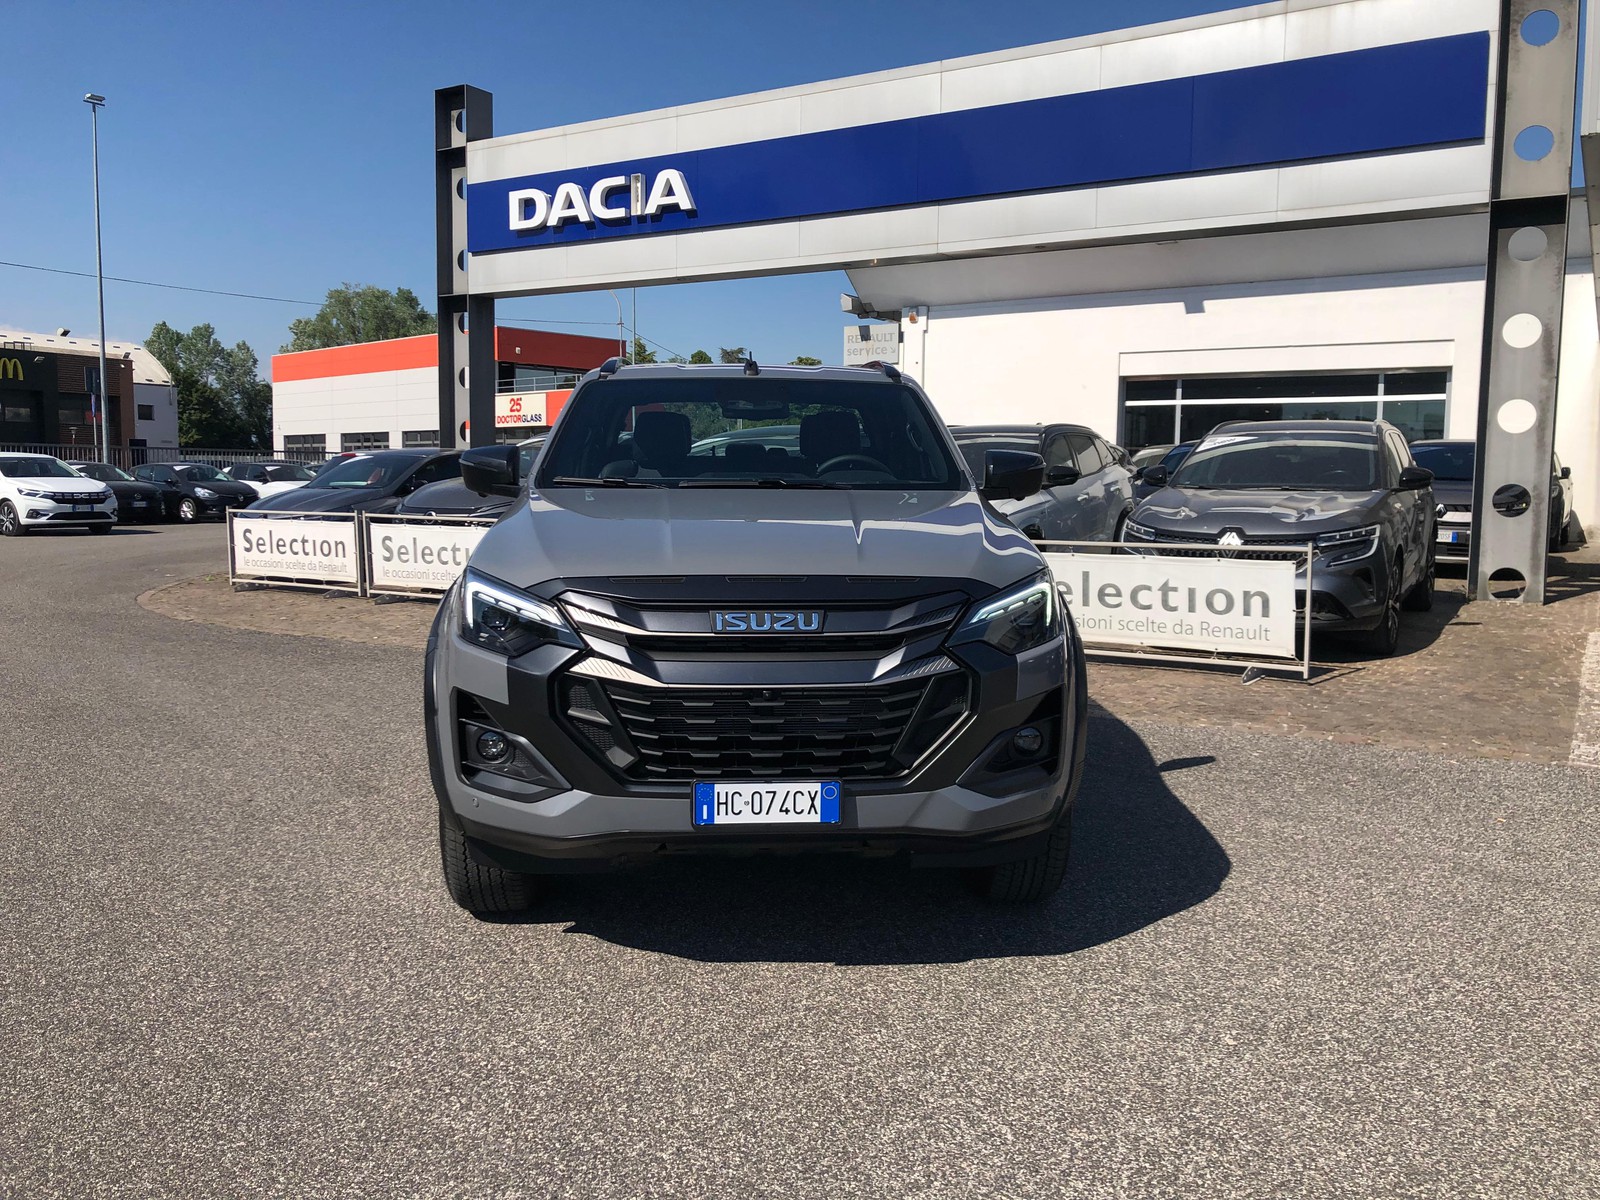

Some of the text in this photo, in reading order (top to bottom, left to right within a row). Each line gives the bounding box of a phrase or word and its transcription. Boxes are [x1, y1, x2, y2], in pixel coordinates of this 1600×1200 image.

[508, 168, 696, 231] DACIA
[847, 332, 895, 344] RENAULT
[847, 344, 888, 356] service
[496, 413, 542, 424] DOCTORGLASS
[242, 527, 346, 558] Selection
[381, 535, 470, 566] Selecti
[243, 556, 348, 573] le occasioni scelte da Renault
[383, 566, 457, 581] le occasioni scelte
[1055, 570, 1270, 618] election
[715, 612, 819, 631] ISUZU
[1075, 614, 1270, 641] sioni scelte da Renault
